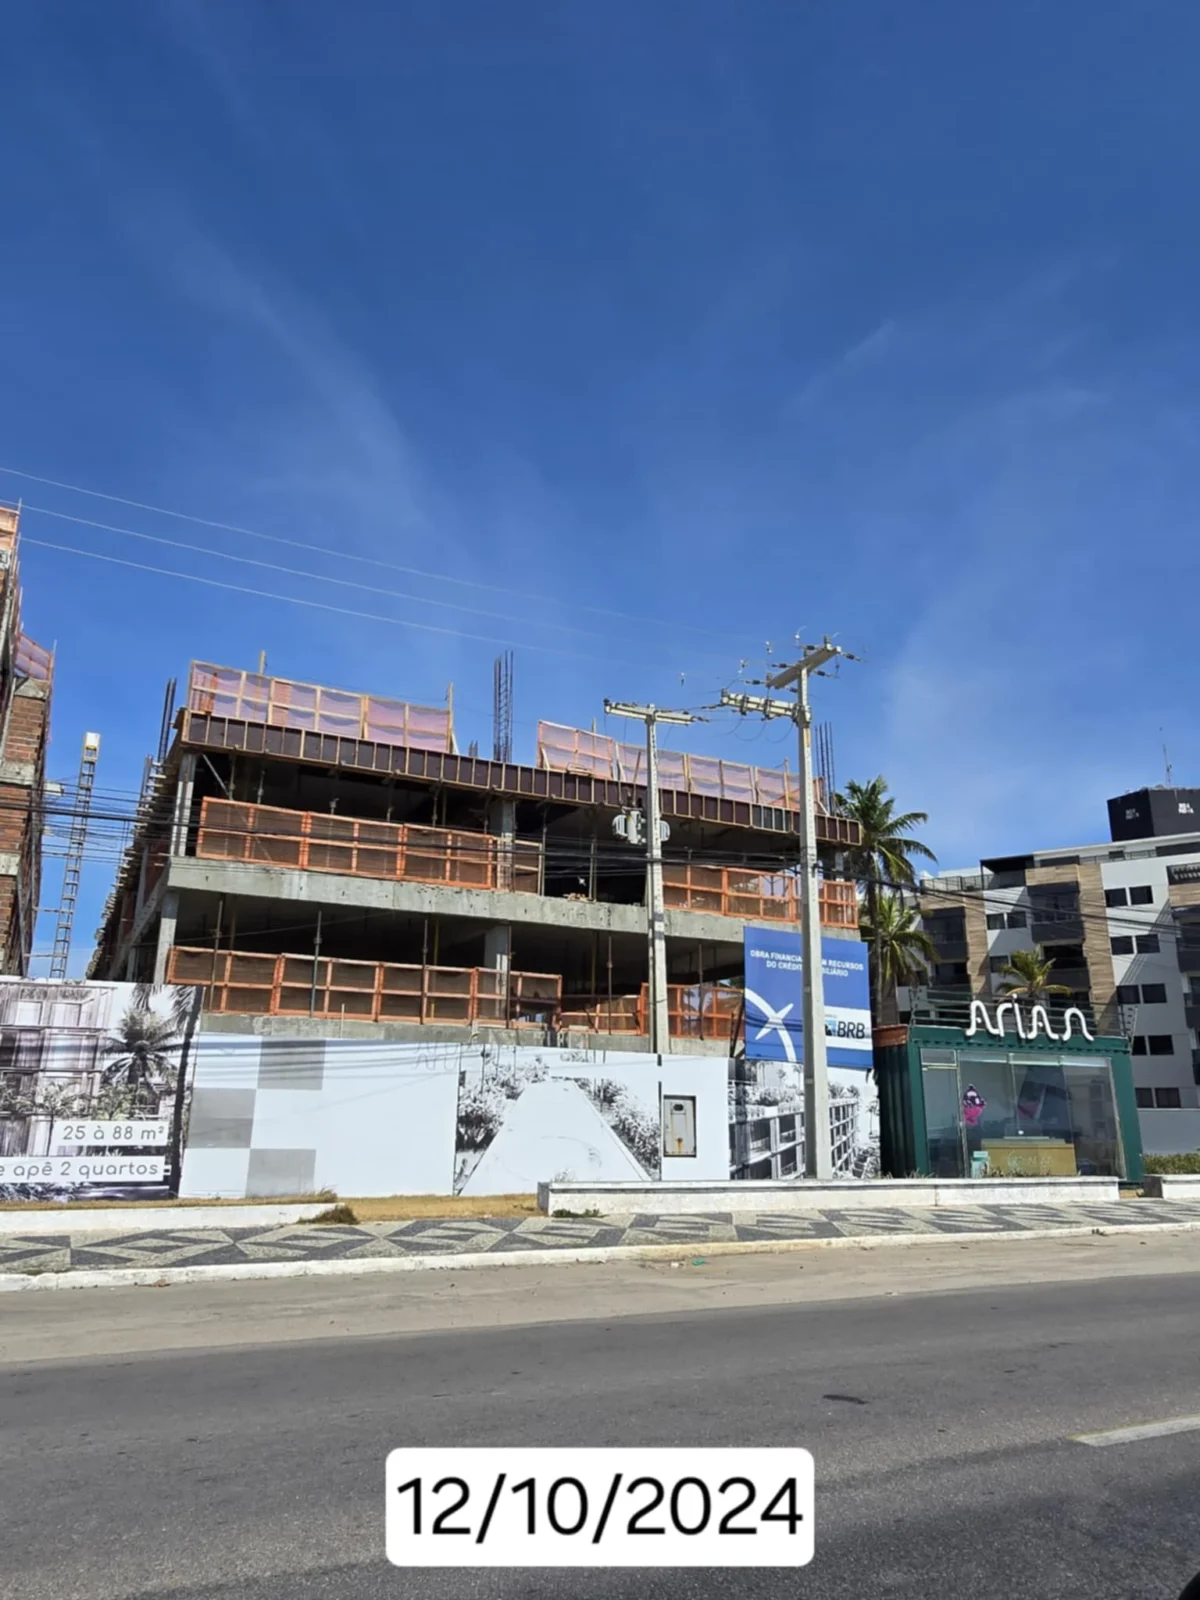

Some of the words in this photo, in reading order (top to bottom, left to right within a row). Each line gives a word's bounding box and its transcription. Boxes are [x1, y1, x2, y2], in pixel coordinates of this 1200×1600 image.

[750, 949, 769, 959] OBRA
[771, 952, 803, 963] FINANCIA
[828, 959, 864, 971] RECURSOS
[766, 960, 777, 969] DO
[778, 961, 803, 972] CRÉDIT
[837, 1020, 865, 1039] BRB
[63, 1125, 86, 1141] 25
[93, 1125, 105, 1140] à
[112, 1125, 133, 1140] 88
[140, 1126, 165, 1140] m²
[13, 1161, 53, 1180] apê
[60, 1162, 71, 1176] 2
[78, 1162, 158, 1179] quartos
